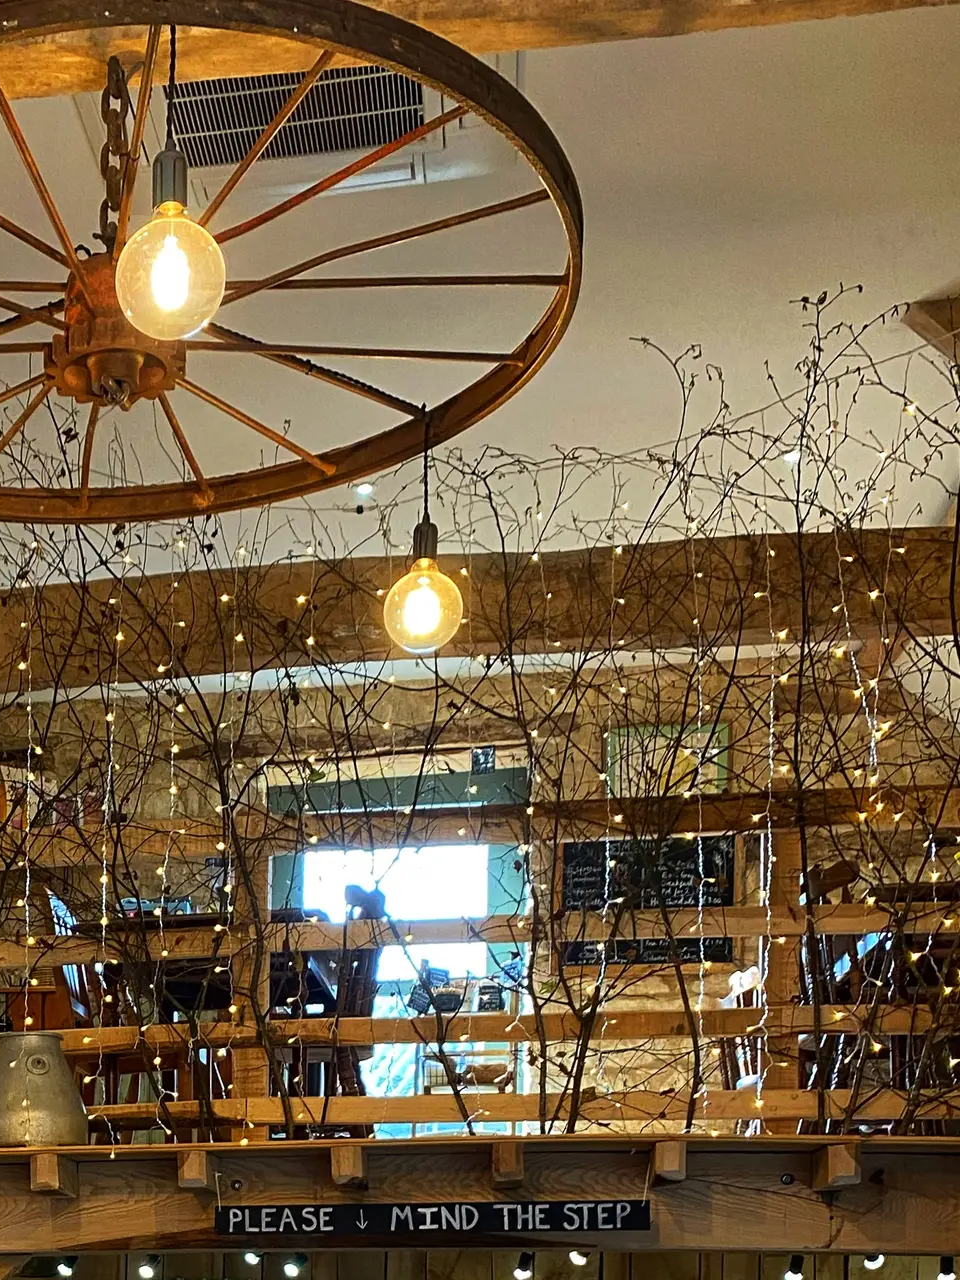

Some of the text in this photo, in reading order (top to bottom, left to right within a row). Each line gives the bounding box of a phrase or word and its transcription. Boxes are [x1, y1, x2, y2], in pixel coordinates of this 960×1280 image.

[228, 1201, 632, 1233] PLEASE MIND THE STEP
